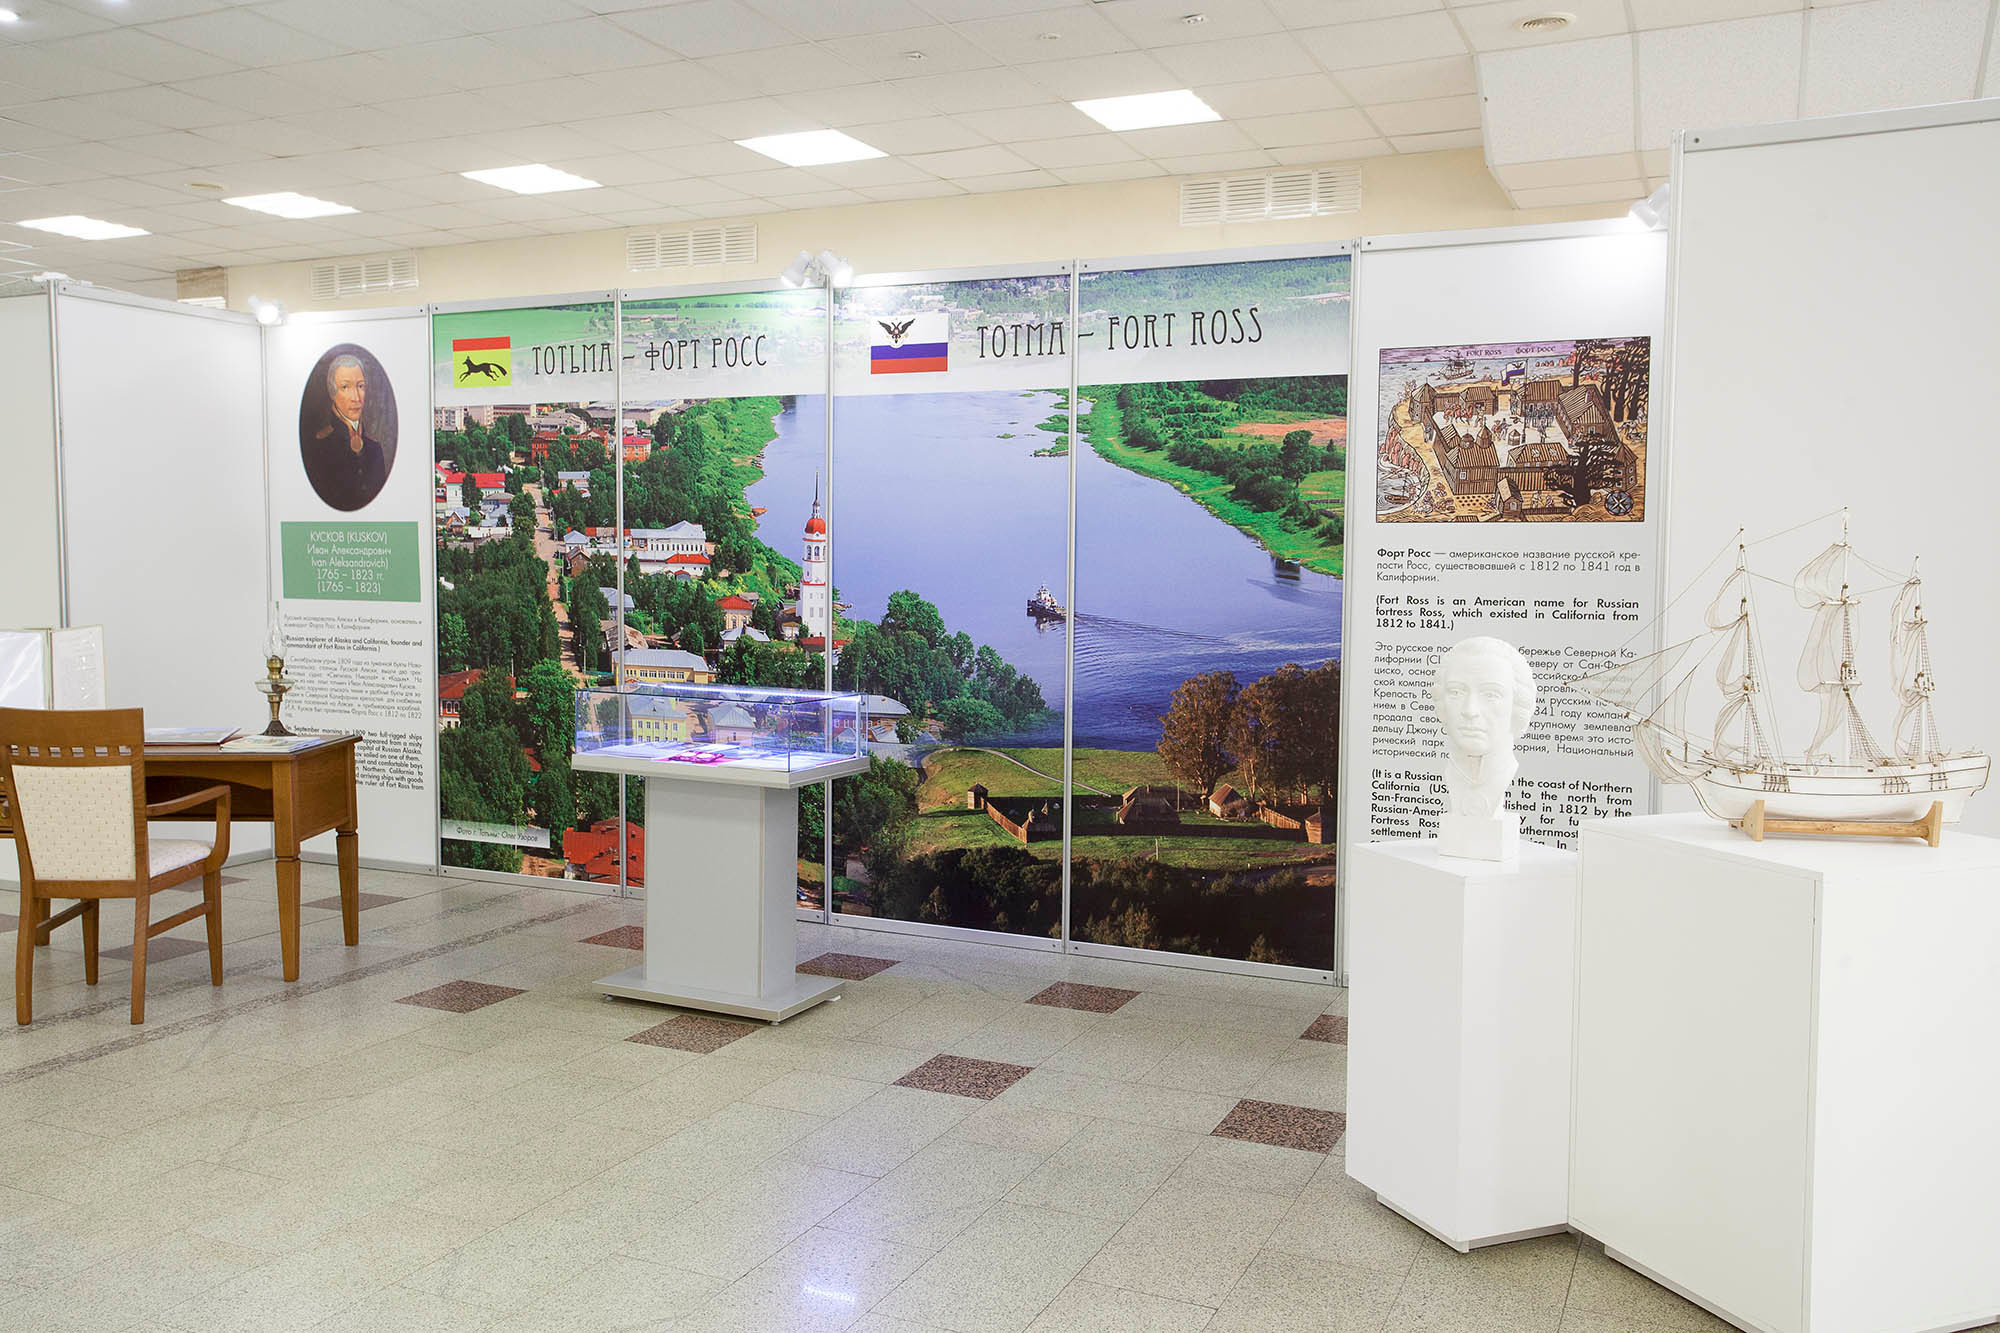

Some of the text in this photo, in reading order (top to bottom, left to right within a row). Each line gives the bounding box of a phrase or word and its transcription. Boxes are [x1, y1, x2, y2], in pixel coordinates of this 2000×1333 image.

[976, 322, 1065, 358] TOTMA
[1107, 313, 1176, 350] FORT
[1190, 307, 1262, 346] ROSS
[532, 343, 613, 375] ТОТЬМА
[644, 338, 701, 370] ФОРТ
[711, 334, 767, 368] РОСС
[310, 531, 387, 544] КУСКОВ (KUSKOV)
[307, 544, 391, 557] Иван Александрович
[1377, 548, 1640, 561] Форт Росс американское название русской кре-
[311, 556, 388, 569] Ivan Aleksandrovich)
[1377, 562, 1404, 570] пости
[1407, 560, 1431, 571] Росс,
[1435, 562, 1516, 572] существовавшей
[1530, 561, 1559, 570] 1812
[1581, 561, 1609, 571] 1841
[1614, 564, 1630, 572] год
[317, 569, 339, 580] 1765
[351, 570, 374, 580] 1823
[1376, 571, 1439, 583] Калифорнии.
[317, 581, 381, 595] (1765 1823)
[1376, 595, 1639, 608] (Fort Ross is an American name for Russian
[1376, 606, 1639, 620] fortress Ross, which existed in California from
[1376, 618, 1454, 631] 1812 to 1841.)
[1375, 641, 1393, 651] Это
[1396, 645, 1433, 654] русское
[1564, 646, 1616, 659] Северной
[1620, 648, 1637, 658] Ка-
[1375, 653, 1422, 665] лифорнии
[1374, 668, 1403, 677] циско,
[1399, 680, 1434, 688] компан
[1373, 688, 1417, 699] Крепость
[1374, 702, 1396, 710] нием
[1550, 697, 1591, 707] русским
[1373, 714, 1412, 723] продала
[1561, 710, 1582, 720] году
[1372, 726, 1403, 735] дельцу
[1406, 724, 1437, 737] Джону
[1529, 721, 1576, 731] крупному
[1372, 737, 1444, 748] рический парк
[1554, 734, 1584, 743] время
[1608, 736, 1634, 744] исто-
[1372, 749, 1436, 758] исторический
[1557, 744, 1634, 757] Национальный
[1372, 769, 1382, 779] (It
[1384, 769, 1392, 778] is
[1404, 771, 1442, 781] Russian
[1371, 780, 1450, 794] California (US
[1518, 777, 1534, 787] the
[1537, 780, 1566, 789] coast
[1568, 781, 1580, 790] of
[1582, 781, 1633, 793] Northern
[1371, 791, 1444, 806] San-Francisco,
[1521, 790, 1531, 799] to
[1540, 791, 1558, 801] the
[1567, 794, 1597, 804] north
[1606, 794, 1632, 806] from
[1371, 803, 1448, 817] Russian-Ameri
[1504, 800, 1632, 819] lished in 1812 by the
[1371, 815, 1409, 826] Fortress
[1540, 814, 1555, 825] for
[1371, 826, 1438, 839] settlement in
[1557, 839, 1567, 849] In
